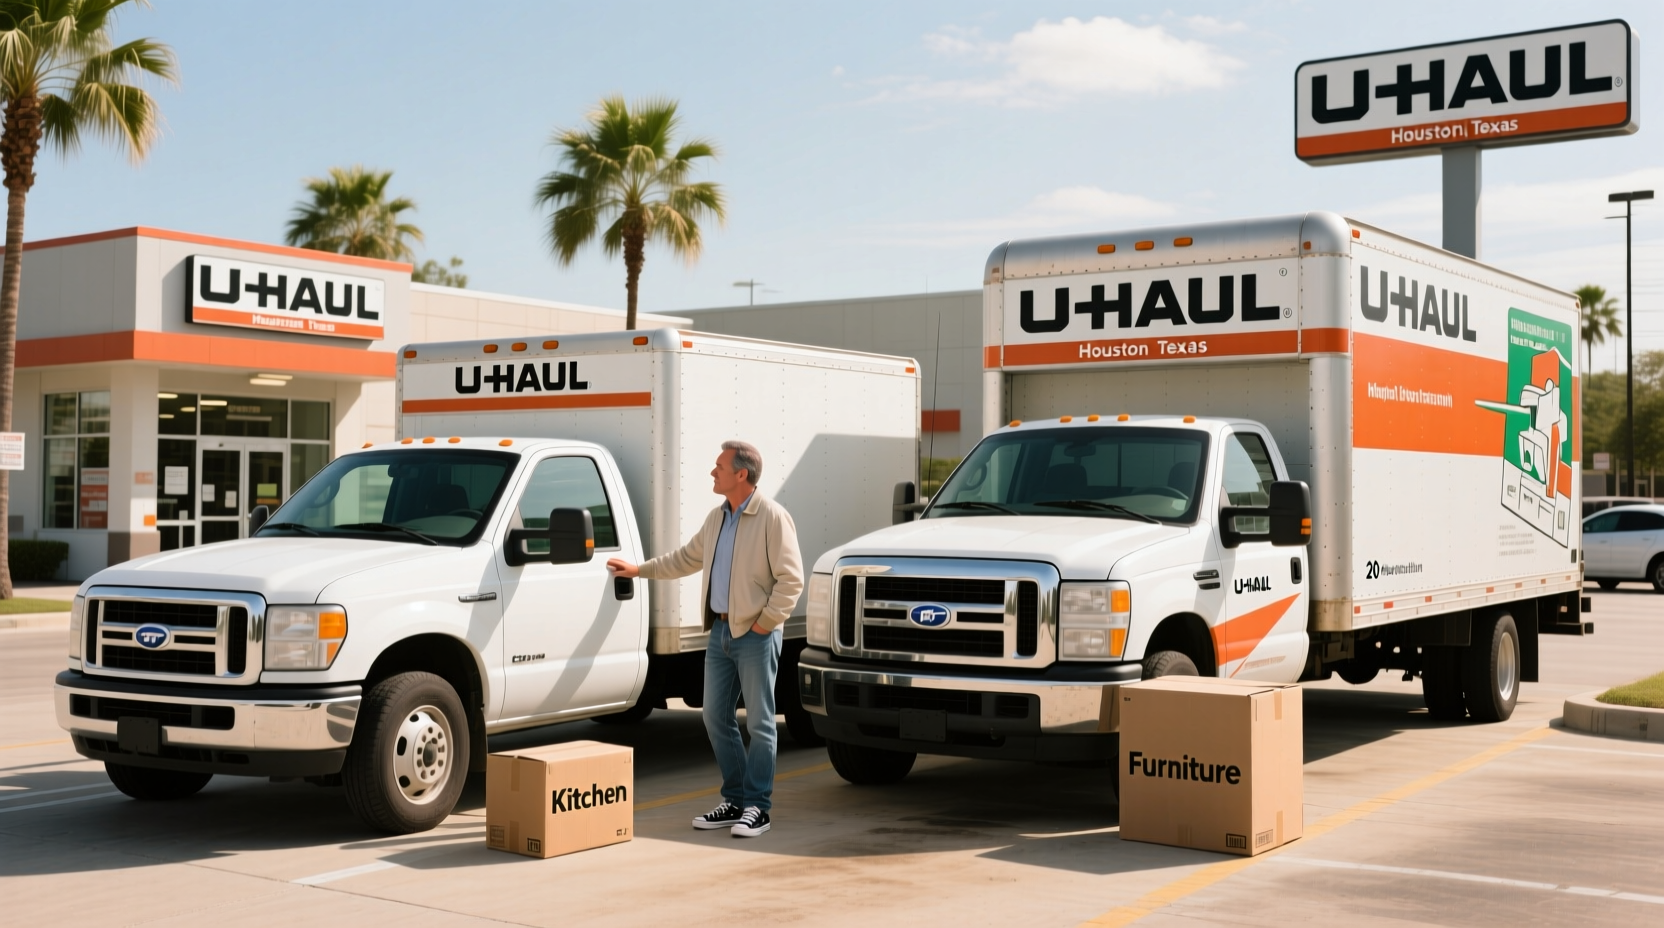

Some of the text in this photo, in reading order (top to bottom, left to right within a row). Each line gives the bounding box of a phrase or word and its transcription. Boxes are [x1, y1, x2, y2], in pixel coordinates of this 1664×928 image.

[1311, 41, 1613, 124] U-HAUL
[1471, 119, 1519, 136] Texas
[200, 264, 380, 321] U-HAUL
[1020, 273, 1281, 334] U-HAUL
[1361, 264, 1477, 343] U-HAUL
[1078, 340, 1208, 359] Houston Texas
[455, 361, 589, 394] U-HAUL
[1365, 560, 1380, 580] 20
[1128, 750, 1242, 785] Furniture
[551, 782, 627, 815] Kitchen
